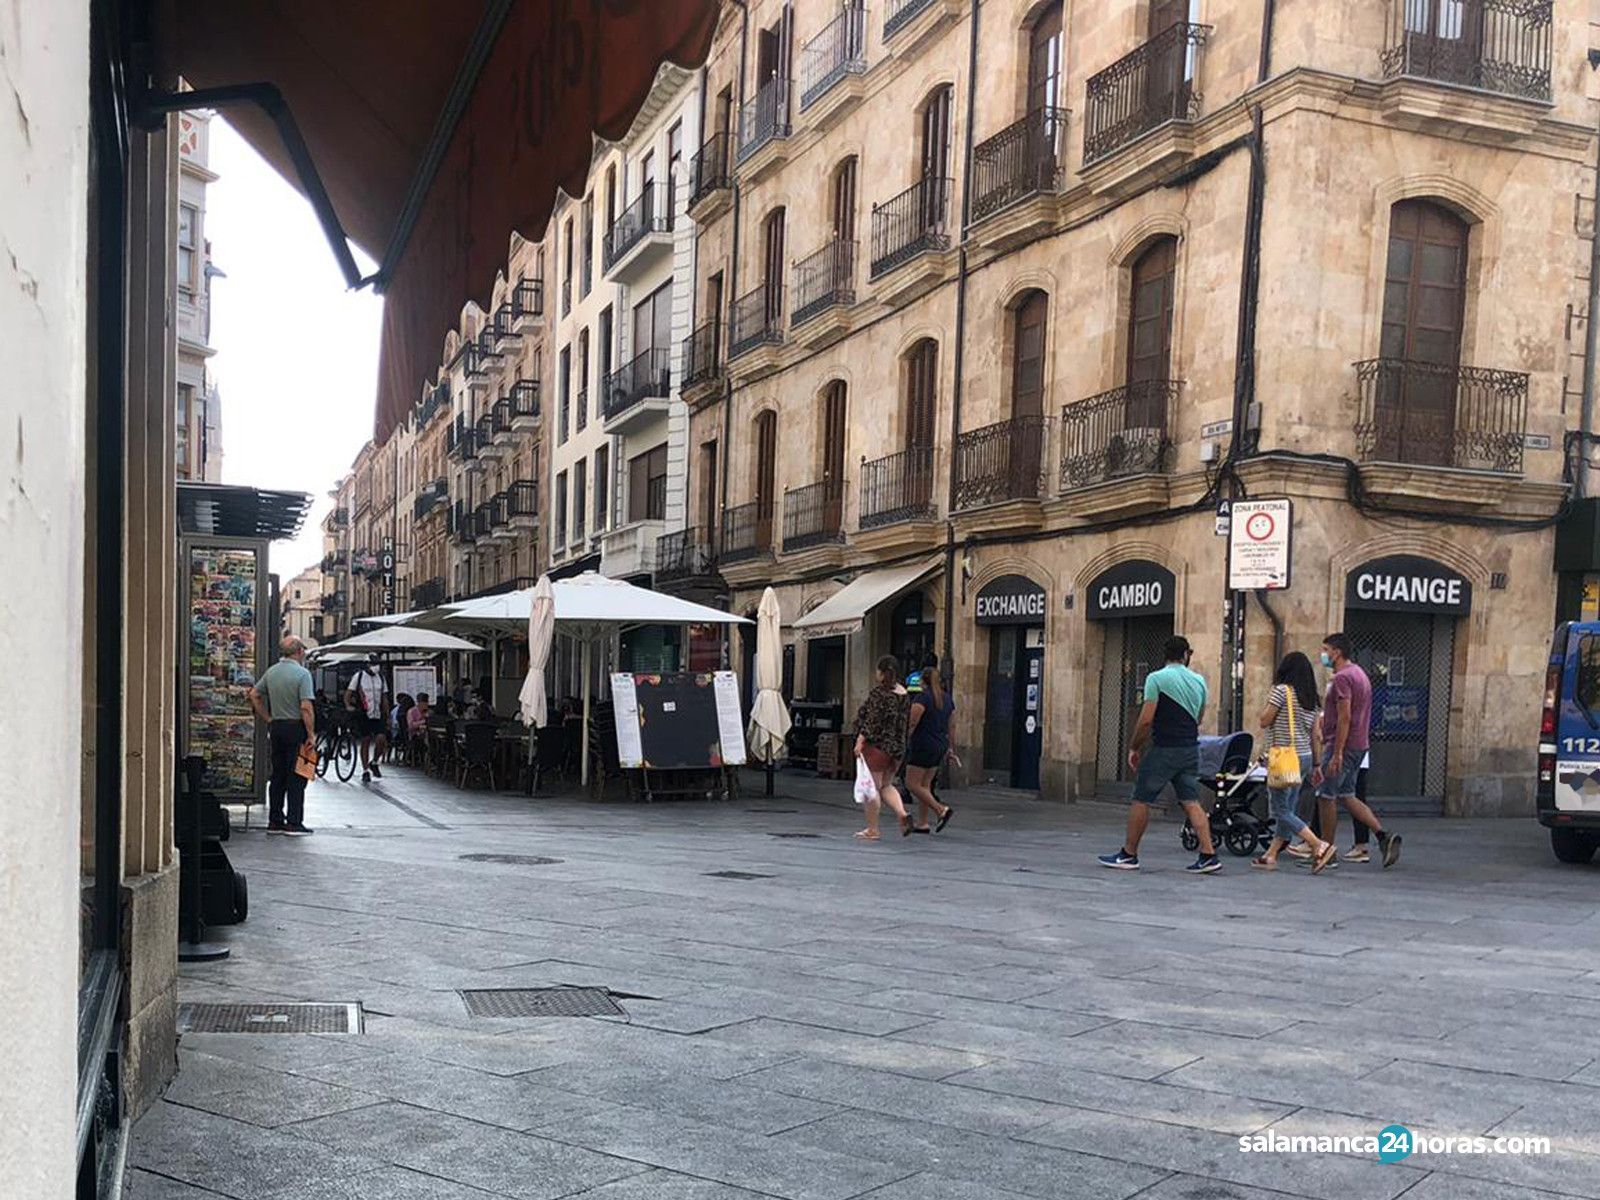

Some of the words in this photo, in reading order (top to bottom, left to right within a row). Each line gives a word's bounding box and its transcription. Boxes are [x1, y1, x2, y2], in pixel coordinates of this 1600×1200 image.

[1234, 504, 1251, 513] ZONA
[1253, 502, 1287, 512] PEATONAL
[1099, 581, 1162, 610] CAMBIO
[1357, 573, 1461, 604] CHANGE
[977, 593, 1045, 617] EXCHANGE
[1562, 737, 1600, 753] 112
